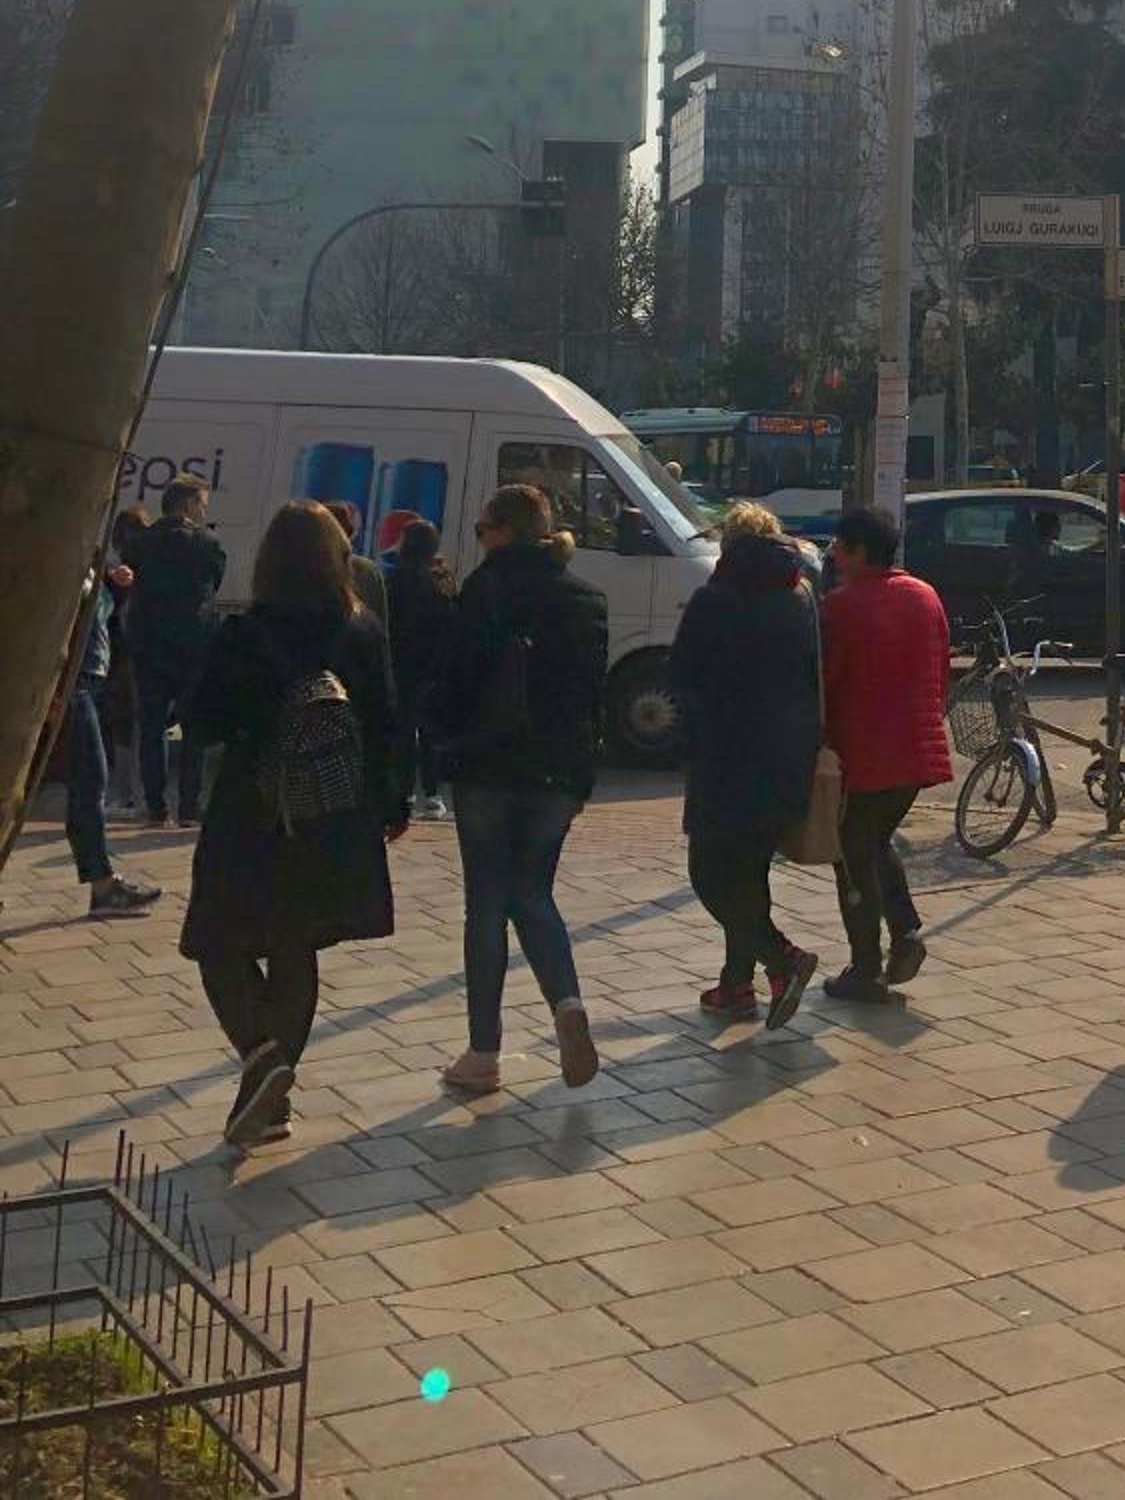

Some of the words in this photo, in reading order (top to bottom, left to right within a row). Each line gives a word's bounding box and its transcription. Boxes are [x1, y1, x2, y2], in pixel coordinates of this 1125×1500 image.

[983, 221, 1023, 236] LUIGJ
[1029, 221, 1099, 238] GURAKUQI
[118, 448, 225, 501] epsi
